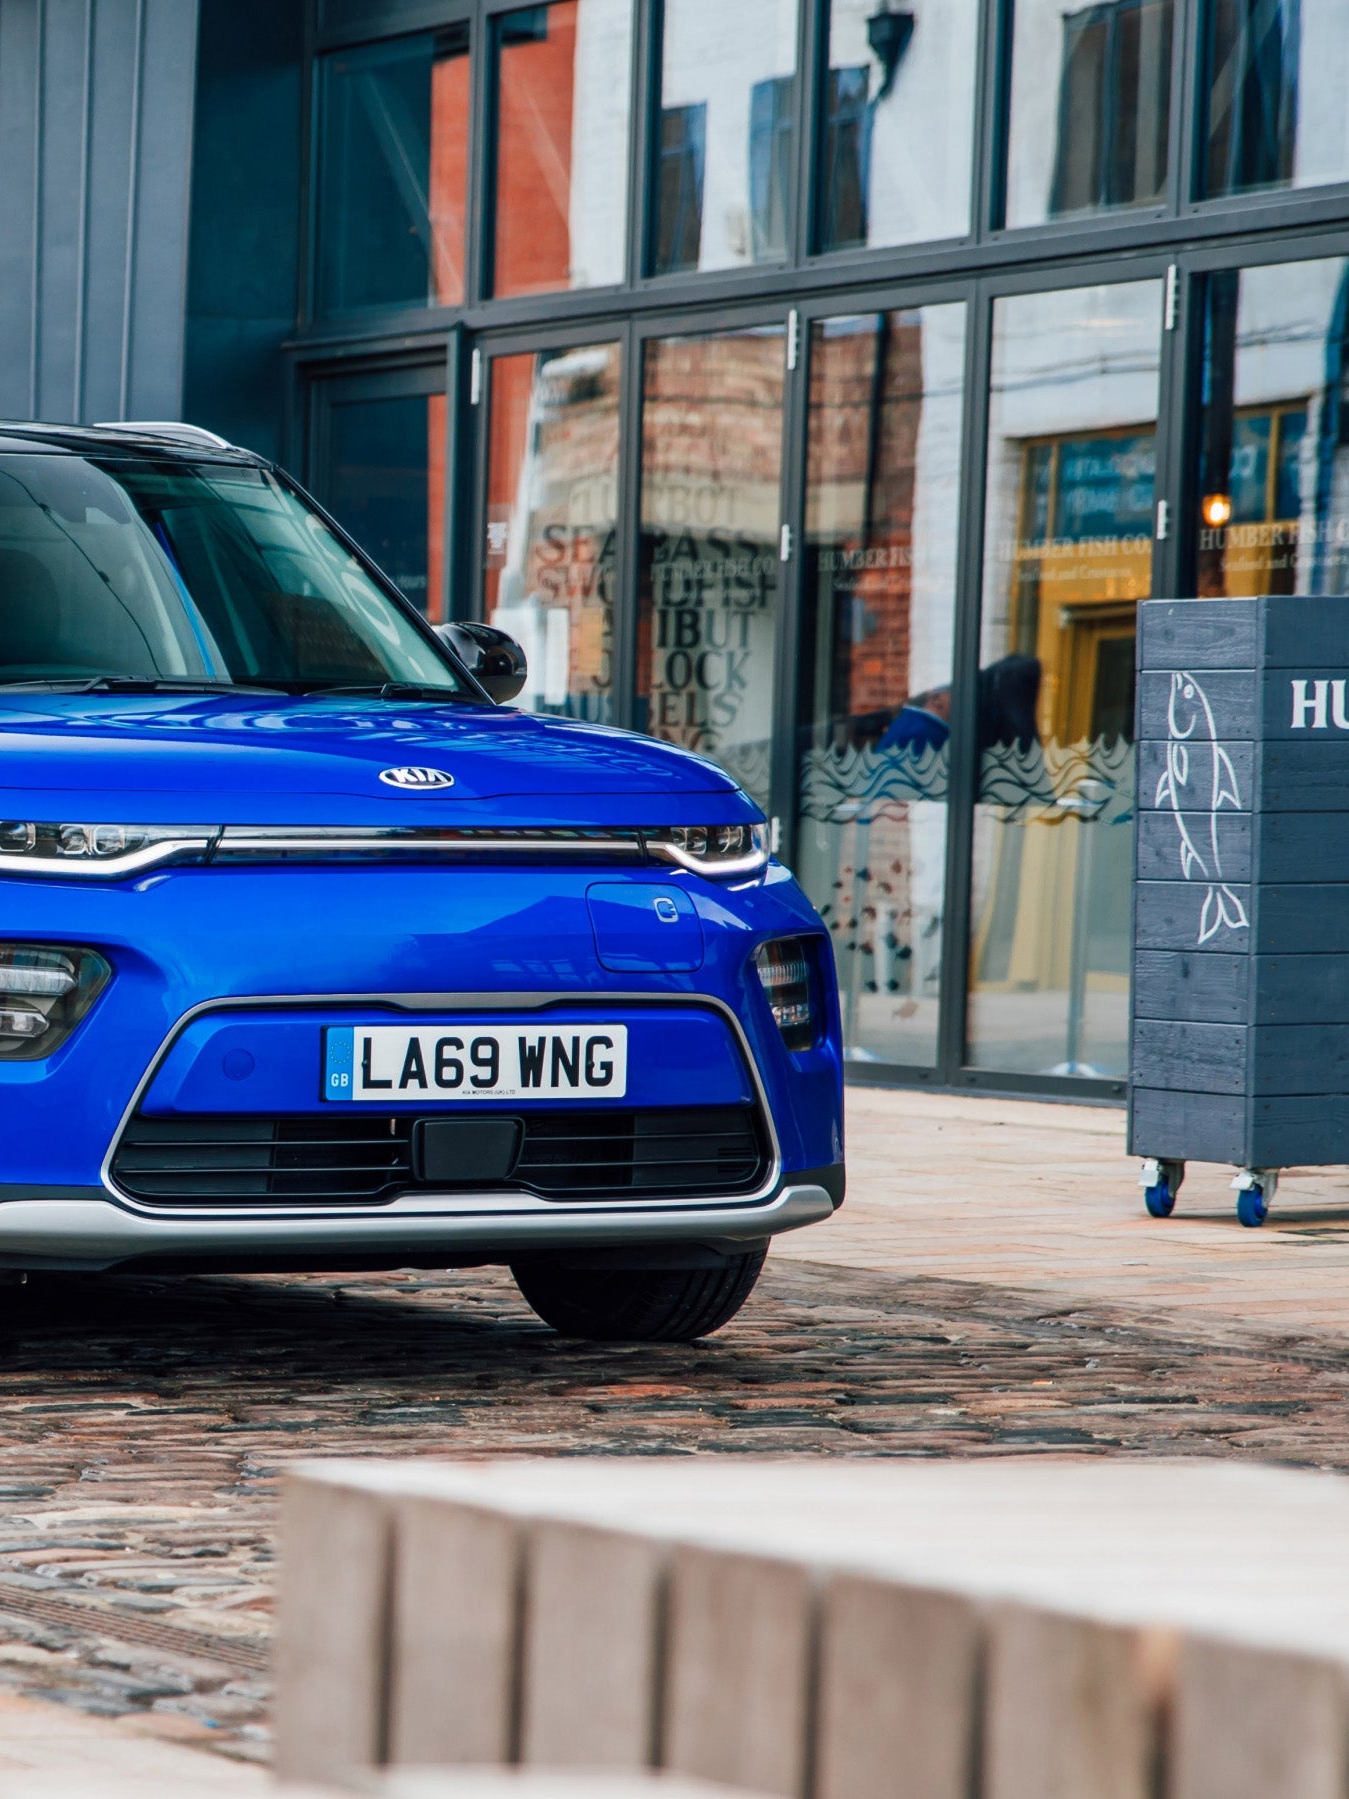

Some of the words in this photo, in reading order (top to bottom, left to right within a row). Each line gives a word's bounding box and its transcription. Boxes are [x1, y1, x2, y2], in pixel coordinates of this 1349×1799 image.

[1199, 523, 1284, 550] HUMBER
[390, 769, 449, 783] KIA
[361, 1036, 500, 1089] LA69
[518, 1036, 614, 1088] WNG
[331, 1073, 348, 1088] GB
